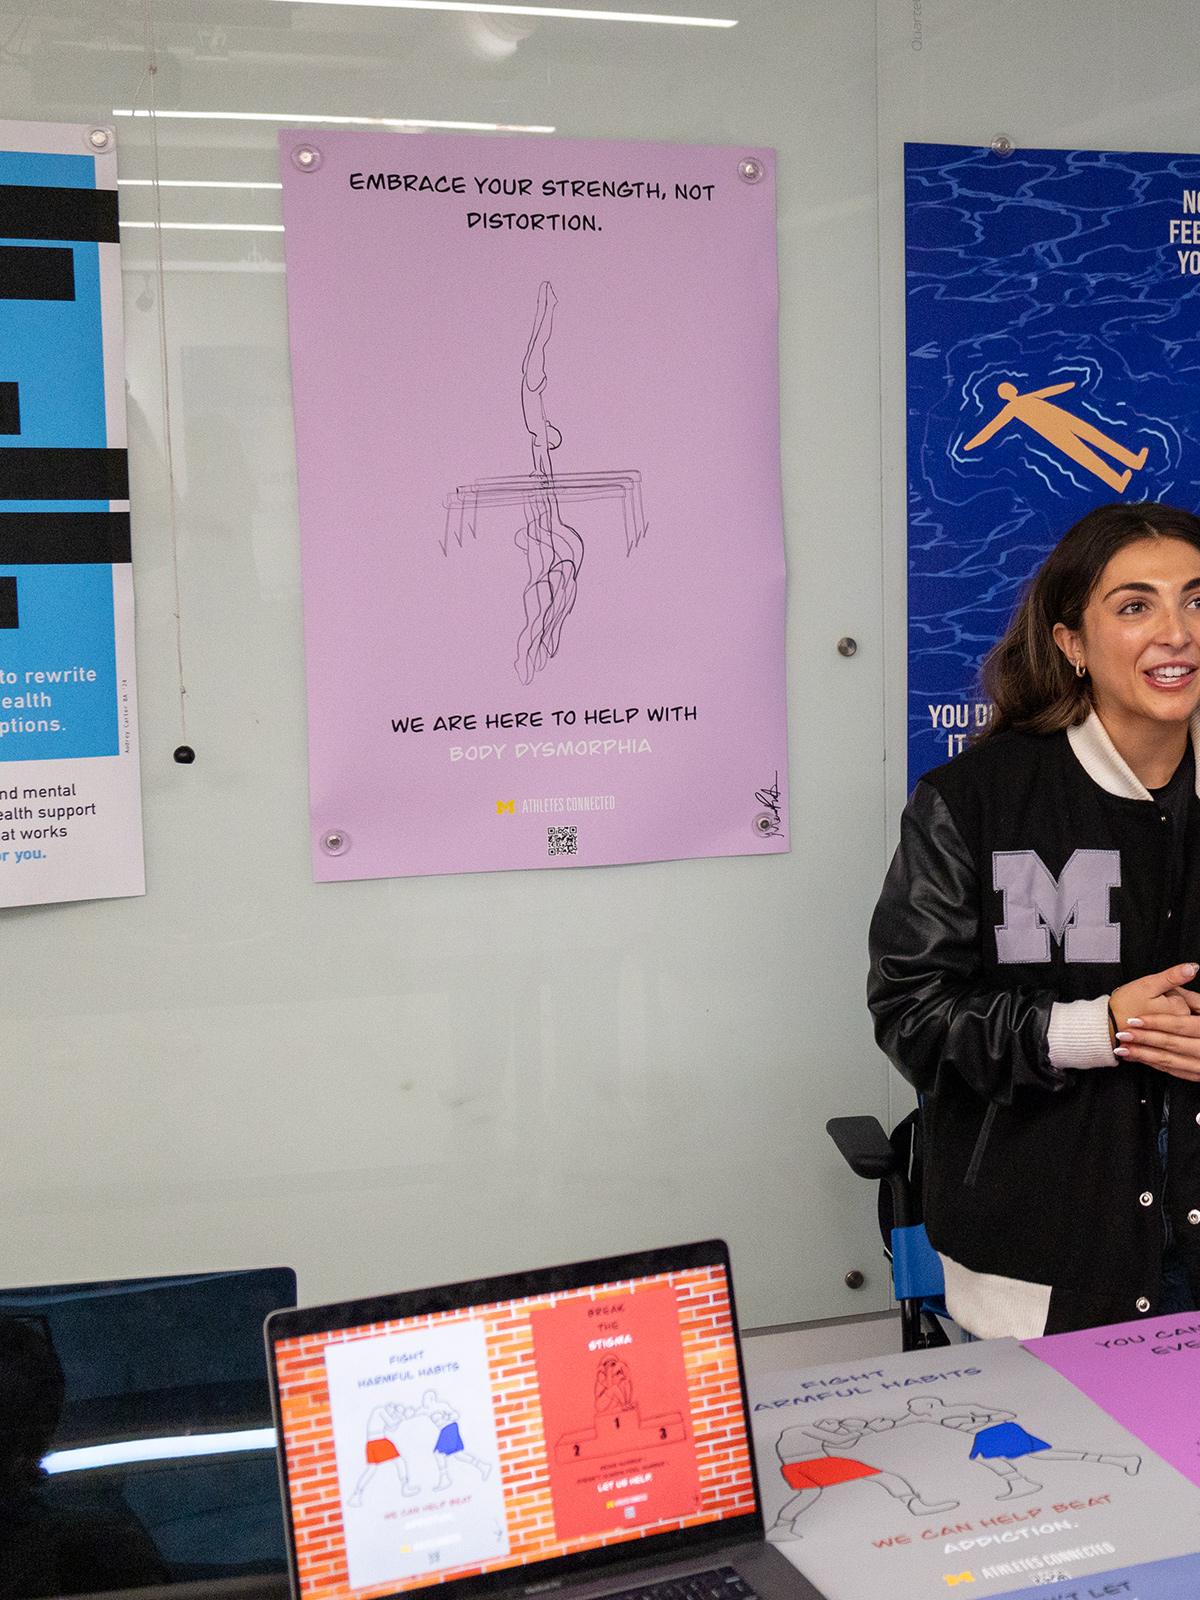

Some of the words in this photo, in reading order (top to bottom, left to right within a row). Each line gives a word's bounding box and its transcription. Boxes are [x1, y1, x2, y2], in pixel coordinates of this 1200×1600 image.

[349, 172, 467, 195] EMBRACE
[474, 177, 533, 197] YOUR
[541, 179, 667, 201] STRENGTH,
[675, 183, 716, 201] NOT
[466, 211, 603, 232] DISTORTION.
[0, 670, 17, 684] to
[25, 666, 97, 684] rewrite
[1, 692, 52, 709] ealth
[391, 717, 424, 734] WE
[432, 714, 477, 732] ARE
[485, 711, 543, 730] HERE
[551, 709, 577, 727] TO
[584, 707, 639, 725] HELP
[647, 705, 698, 723] WITH
[928, 704, 969, 728] YOU
[0, 717, 66, 738] ptions.
[450, 744, 507, 762] BODY
[515, 738, 652, 759] DYSMORPHIA
[948, 733, 967, 757] IT
[23, 783, 77, 799] mental
[38, 803, 96, 821] support
[496, 800, 516, 814] M
[522, 797, 564, 814] ATHLETES
[566, 795, 616, 811] CONNECTED
[1, 828, 16, 841] at
[20, 825, 68, 840] works
[0, 852, 10, 861] r
[14, 849, 47, 864] you.
[992, 848, 1122, 964] M
[587, 1303, 624, 1318] BREAK
[597, 1321, 619, 1332] THE
[588, 1333, 633, 1352] STIGMA
[1095, 1335, 1145, 1349] YOU
[388, 1350, 424, 1365] FIGHT
[357, 1371, 415, 1388] HARMFUL
[418, 1361, 460, 1377] HABITS
[800, 1369, 885, 1389] FIGHT
[753, 1387, 873, 1411] ARMFUL
[881, 1367, 982, 1390] HABITS
[614, 1417, 620, 1429] 1
[659, 1427, 667, 1440] 3
[573, 1444, 580, 1456] 2
[597, 1480, 614, 1493] LET
[615, 1478, 628, 1489] US
[871, 1535, 912, 1549] WE
[921, 1523, 973, 1540] CAN
[979, 1507, 1042, 1529] HELP
[1052, 1494, 1112, 1514] BEAT
[943, 1519, 1079, 1555] ADDICTION.
[980, 1555, 1044, 1580] ATHLETES
[1042, 1541, 1116, 1569] CONNECTED
[1087, 1580, 1131, 1598] LET
